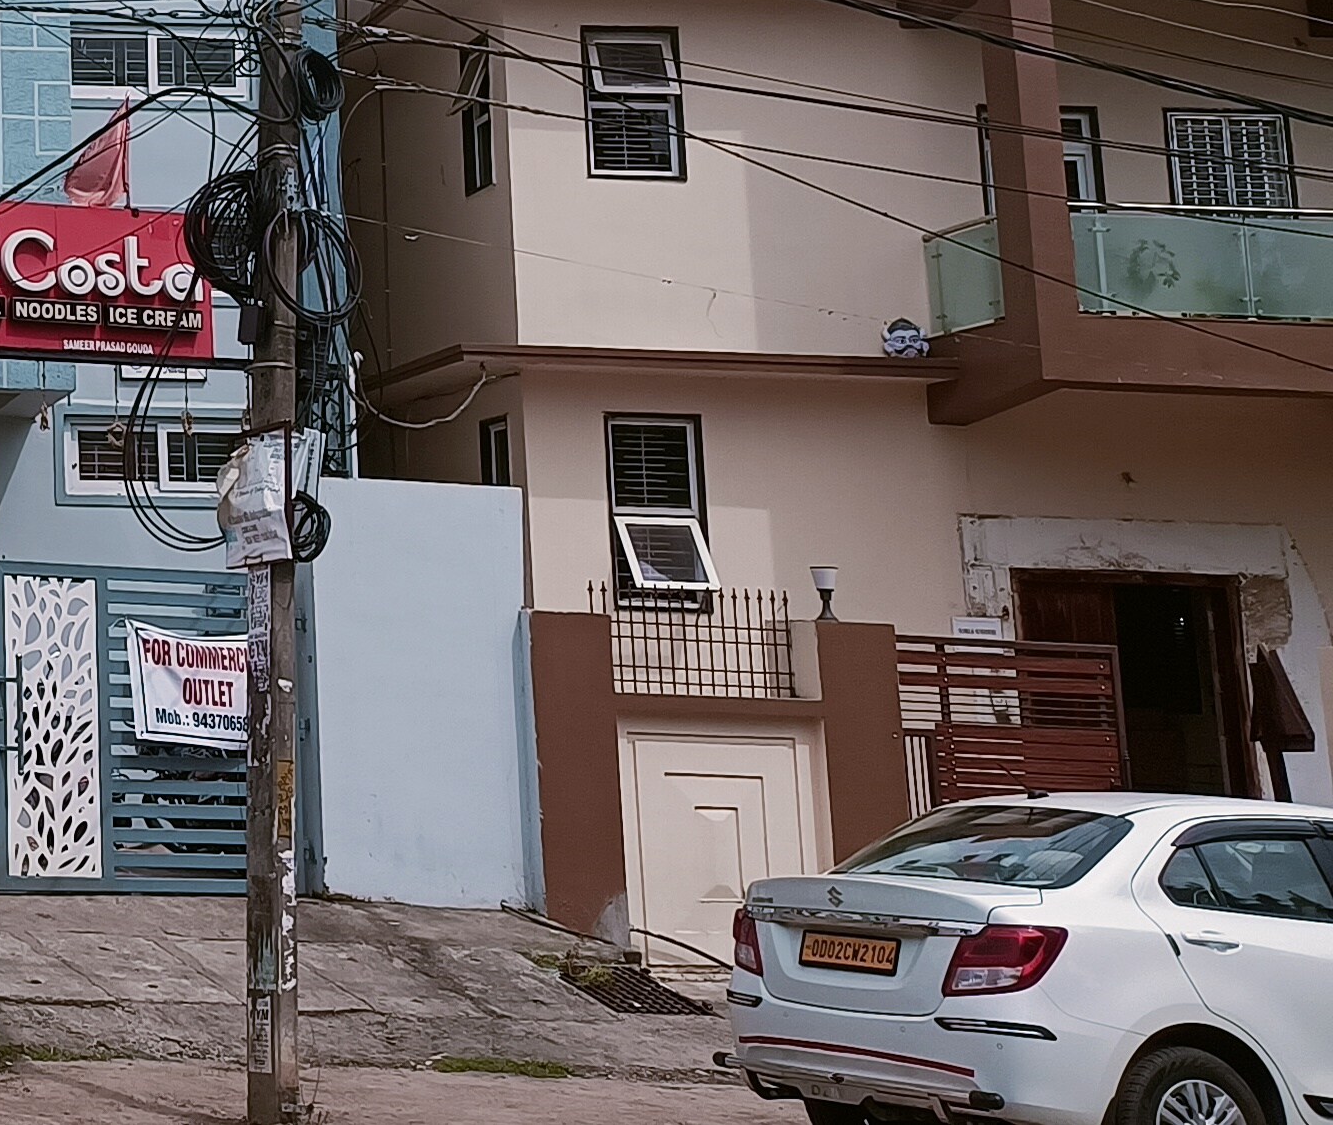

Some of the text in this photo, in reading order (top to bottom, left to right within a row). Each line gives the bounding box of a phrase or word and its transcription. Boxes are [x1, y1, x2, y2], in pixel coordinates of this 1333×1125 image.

[15, 301, 98, 322] NOODLES
[109, 306, 137, 324] ICE
[142, 309, 202, 329] CREAM
[63, 339, 154, 354] SAMEER PRASAD GOUDA
[142, 638, 172, 666] FOR
[176, 641, 248, 673] COMMERCI
[183, 678, 234, 708] OUTLET
[192, 711, 249, 732] 94370658
[811, 938, 895, 965] OD02CW2104
